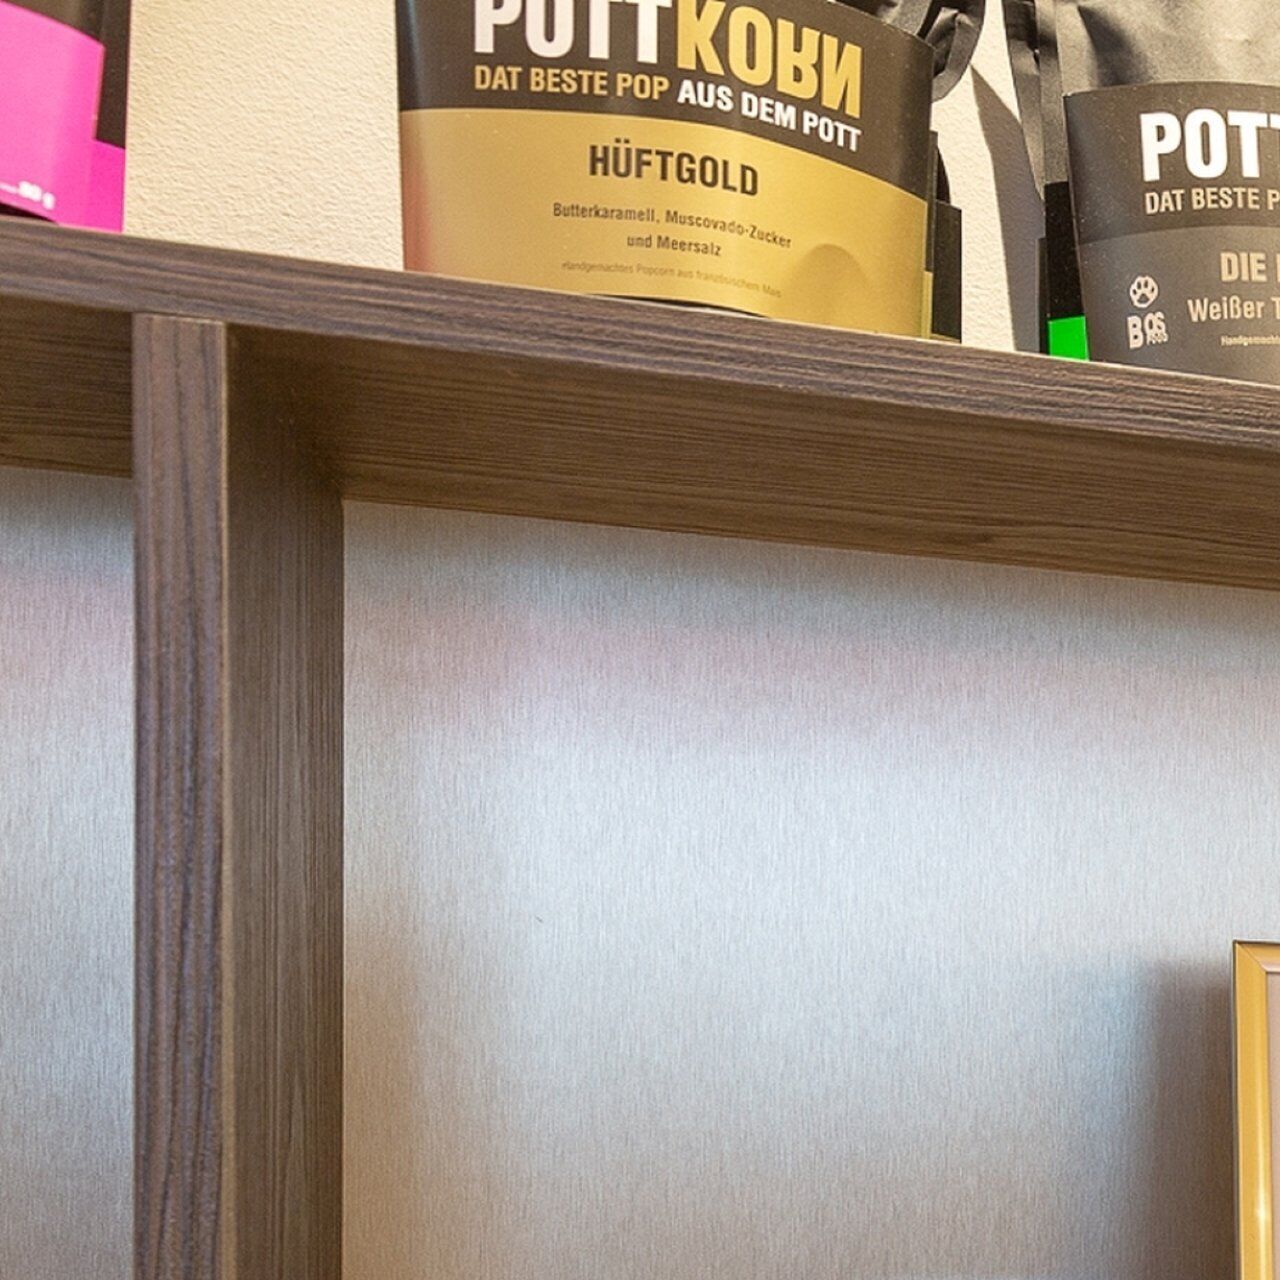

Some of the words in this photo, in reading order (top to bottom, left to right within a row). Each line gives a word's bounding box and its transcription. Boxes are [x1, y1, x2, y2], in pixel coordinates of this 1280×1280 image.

[474, 66, 522, 91] DAT
[530, 67, 608, 96] BESTE
[616, 73, 670, 100] POP
[678, 79, 735, 112] AUS
[742, 93, 797, 131] DEM
[803, 114, 862, 152] POTT
[589, 138, 758, 196] HÜFTGOLD
[1145, 189, 1186, 215] DAT
[1191, 187, 1261, 210] BESTE
[627, 235, 652, 248] und
[656, 235, 722, 257] Meersalz
[1220, 252, 1267, 282] DIE
[1187, 295, 1265, 323] Weißer
